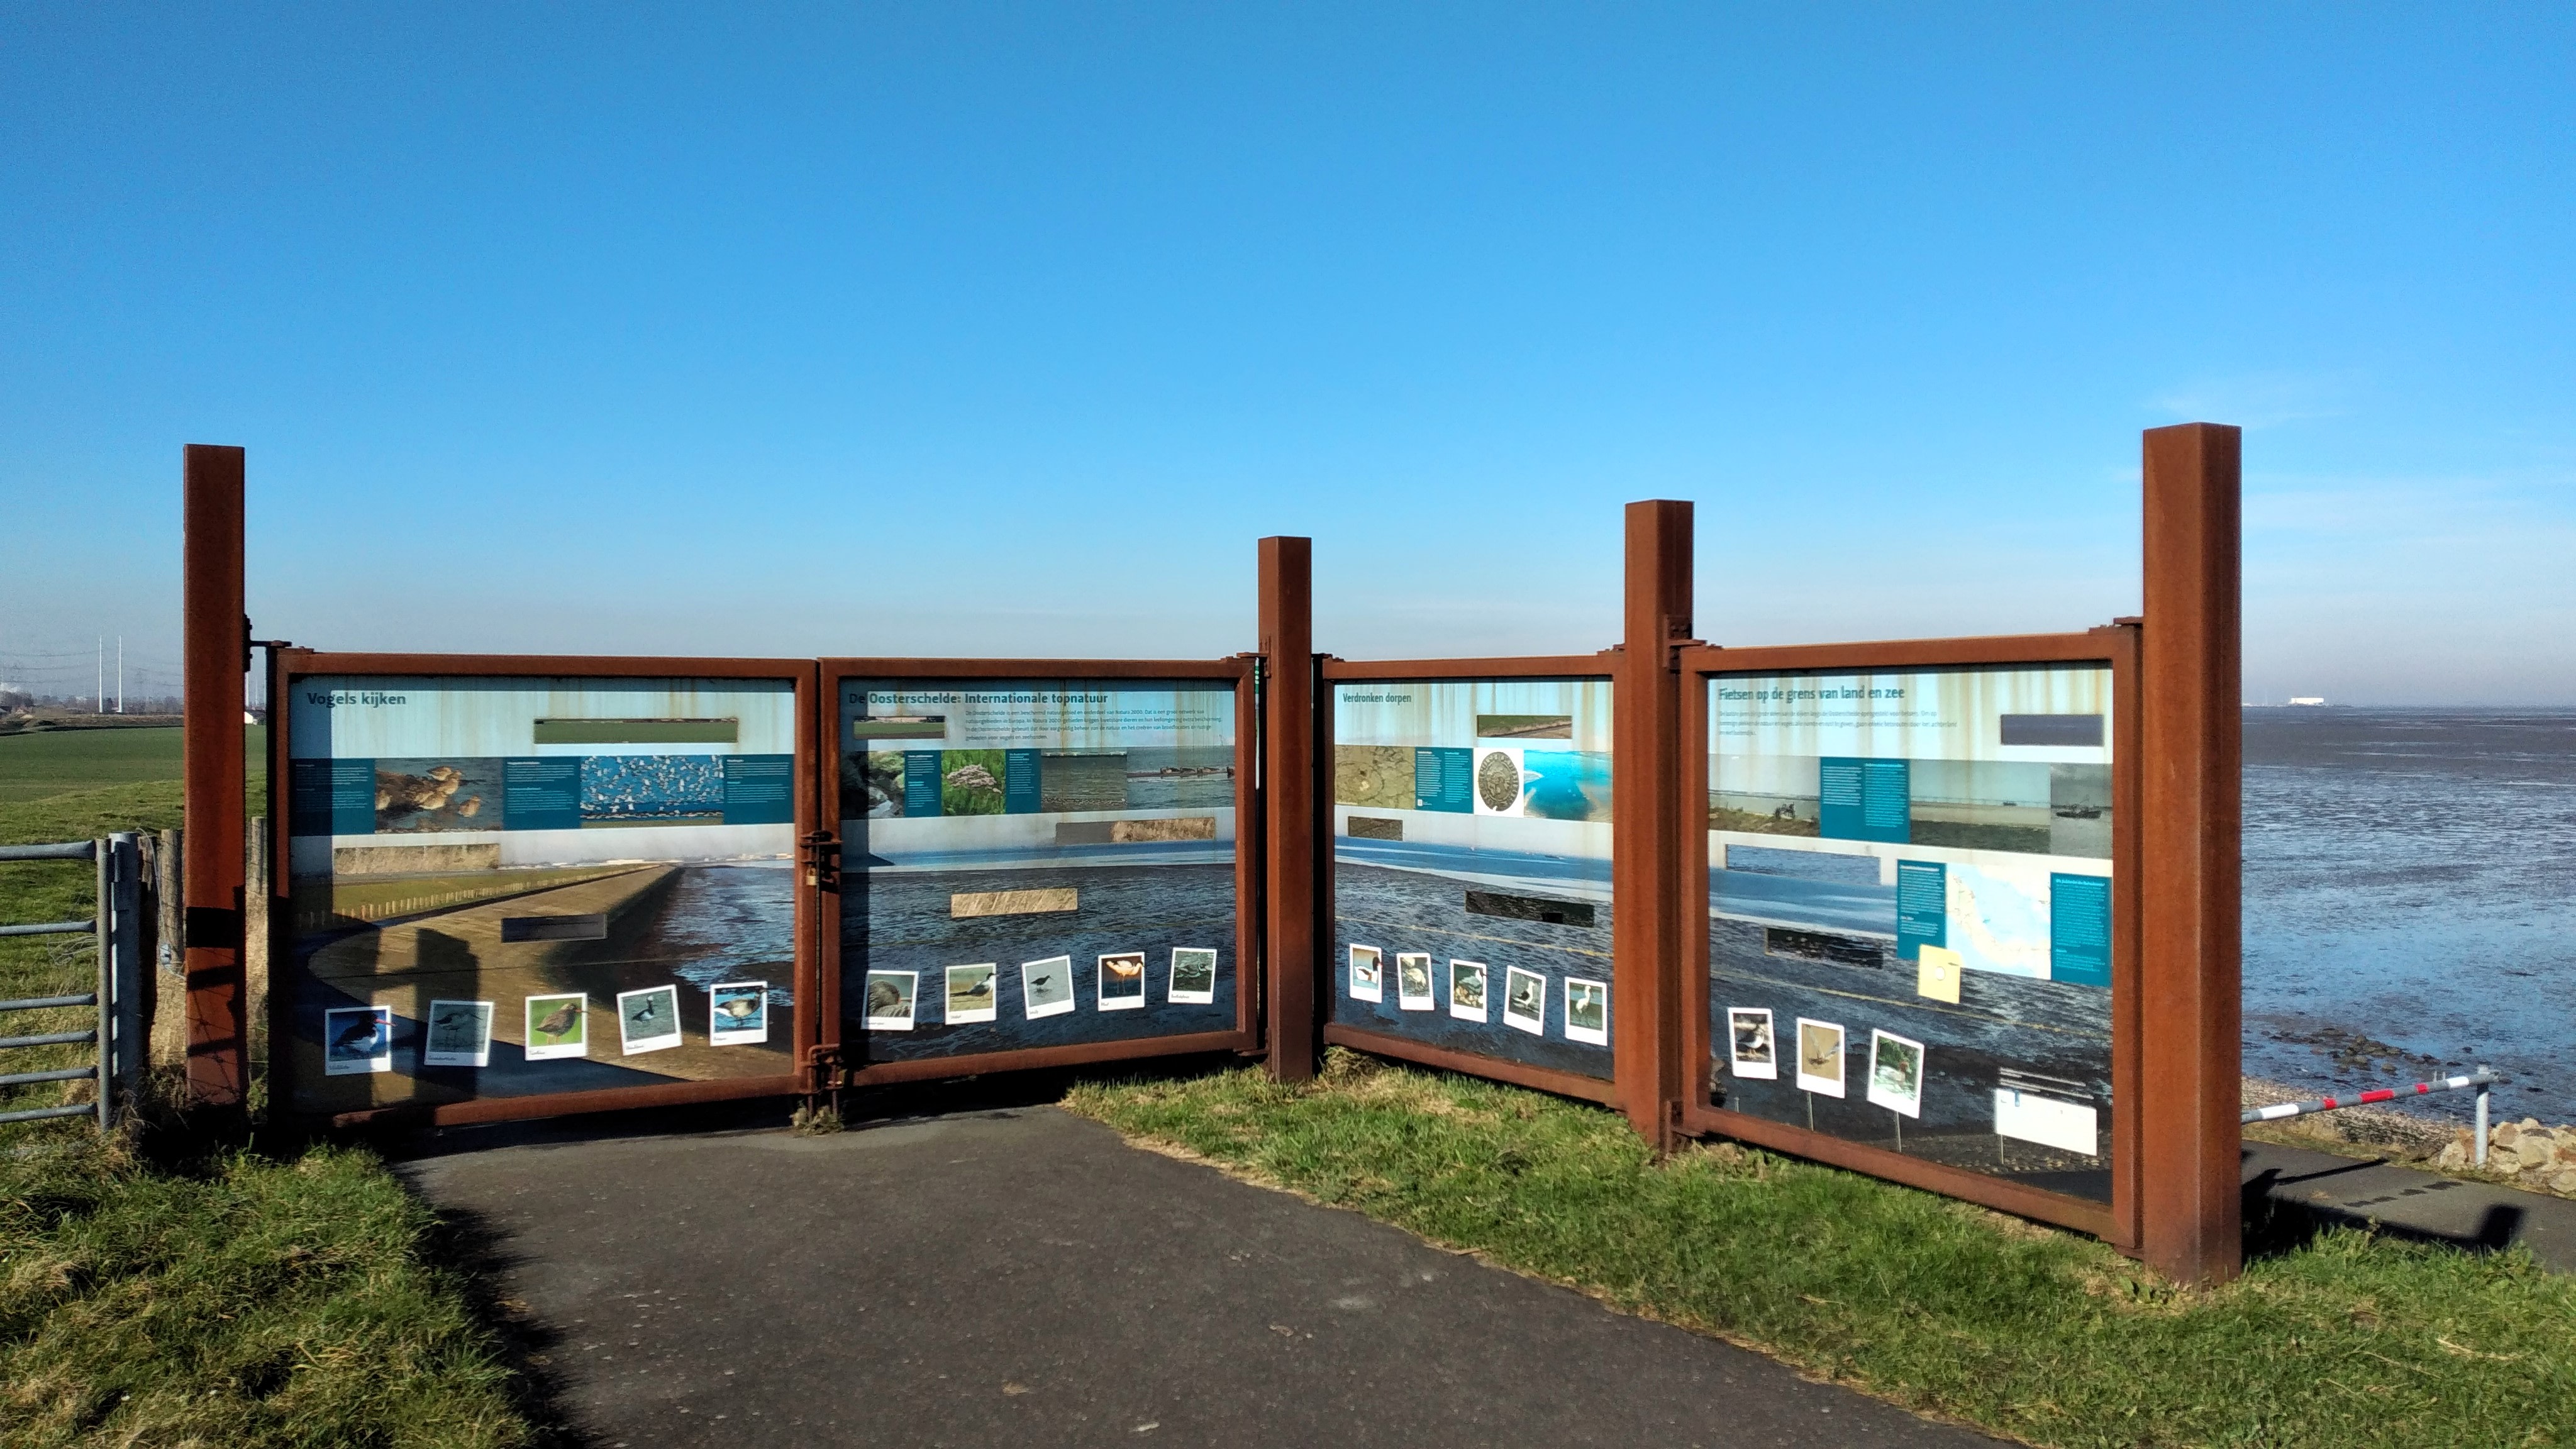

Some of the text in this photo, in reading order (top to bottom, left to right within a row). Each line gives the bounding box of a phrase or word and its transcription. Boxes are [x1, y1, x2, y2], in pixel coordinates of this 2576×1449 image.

[307, 692, 406, 708] Vogels kijken
[850, 692, 1108, 706] De Oosterschelde: Internationale topnatuur
[1343, 692, 1411, 705] Verdronken dorpen
[1719, 686, 1904, 703] Fietsen op de grens van land en zee
